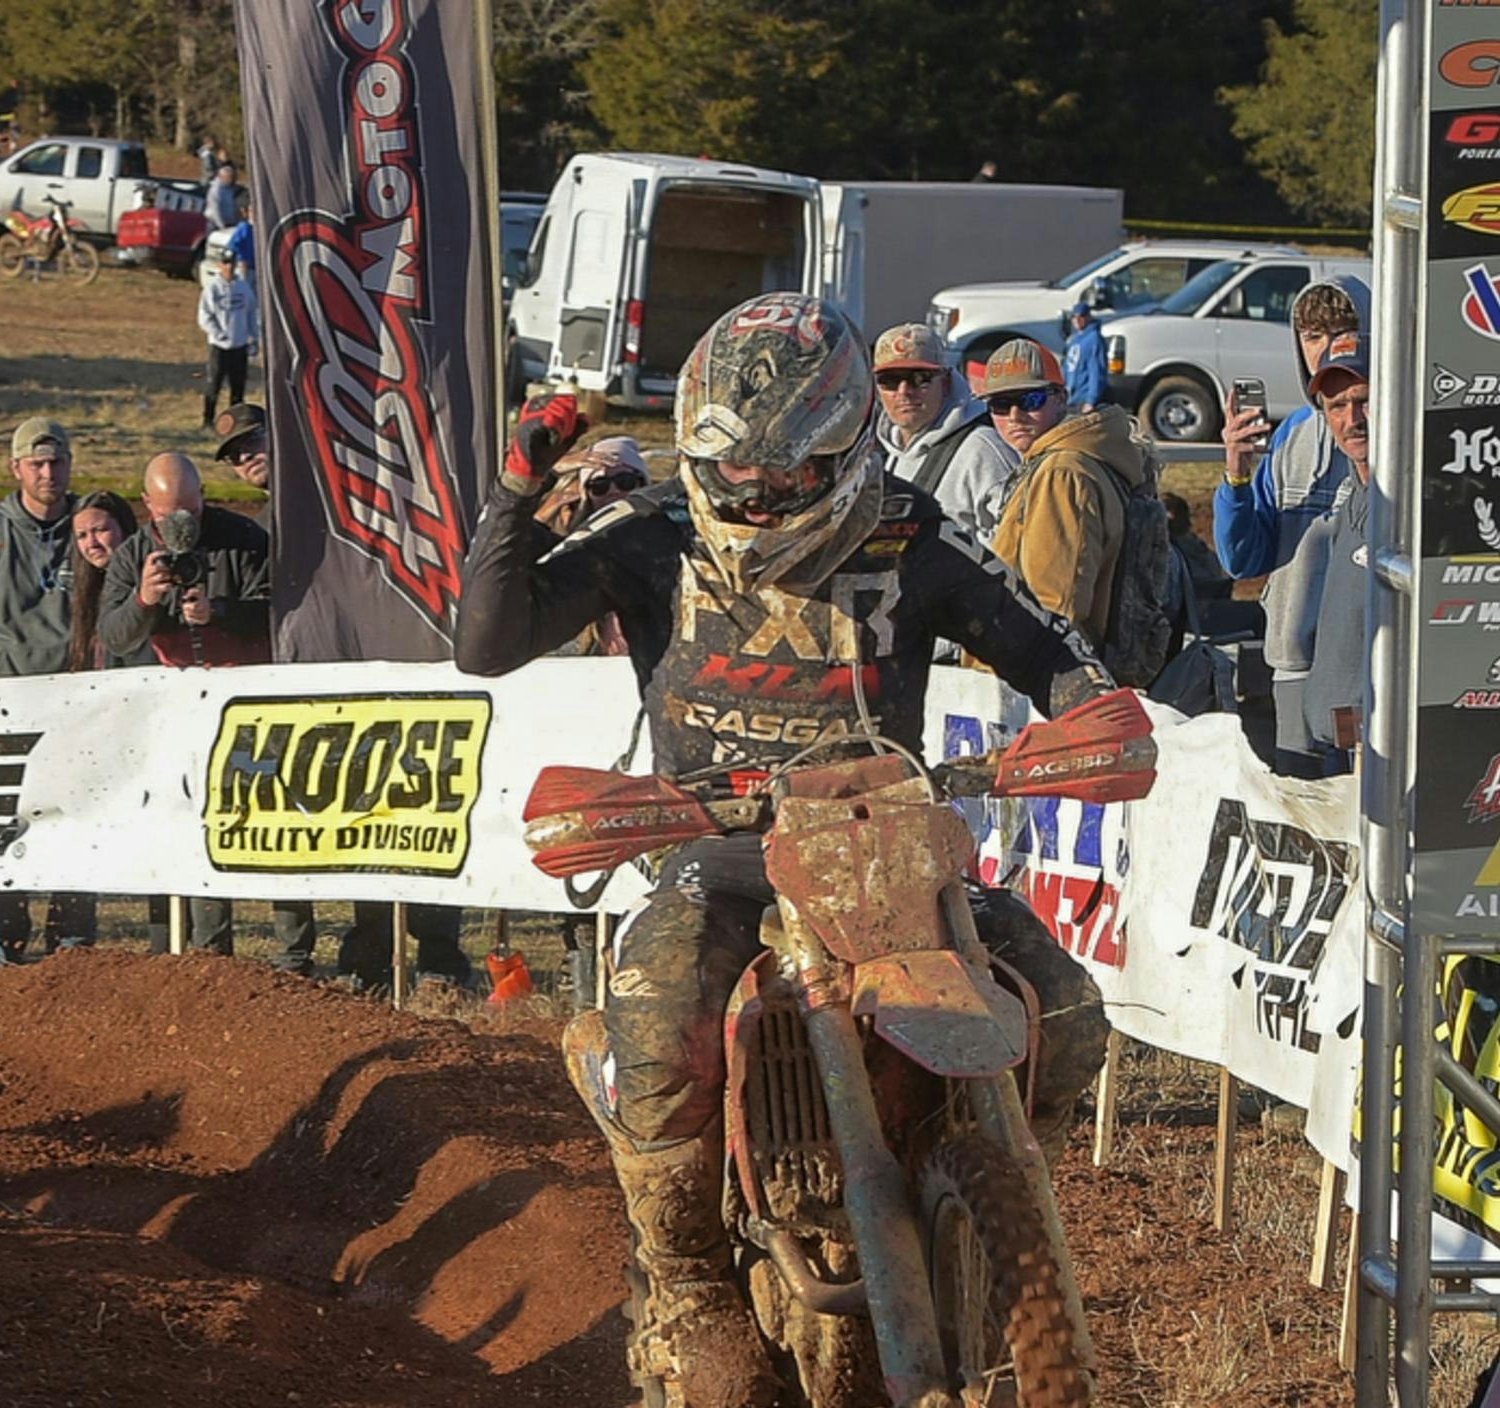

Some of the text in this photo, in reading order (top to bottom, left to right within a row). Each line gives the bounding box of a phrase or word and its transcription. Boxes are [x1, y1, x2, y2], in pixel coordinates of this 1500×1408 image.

[1441, 565, 1500, 584] MIC
[216, 720, 475, 815] MOOSE
[218, 826, 323, 852] UTILITY
[336, 825, 458, 854] DIVISION
